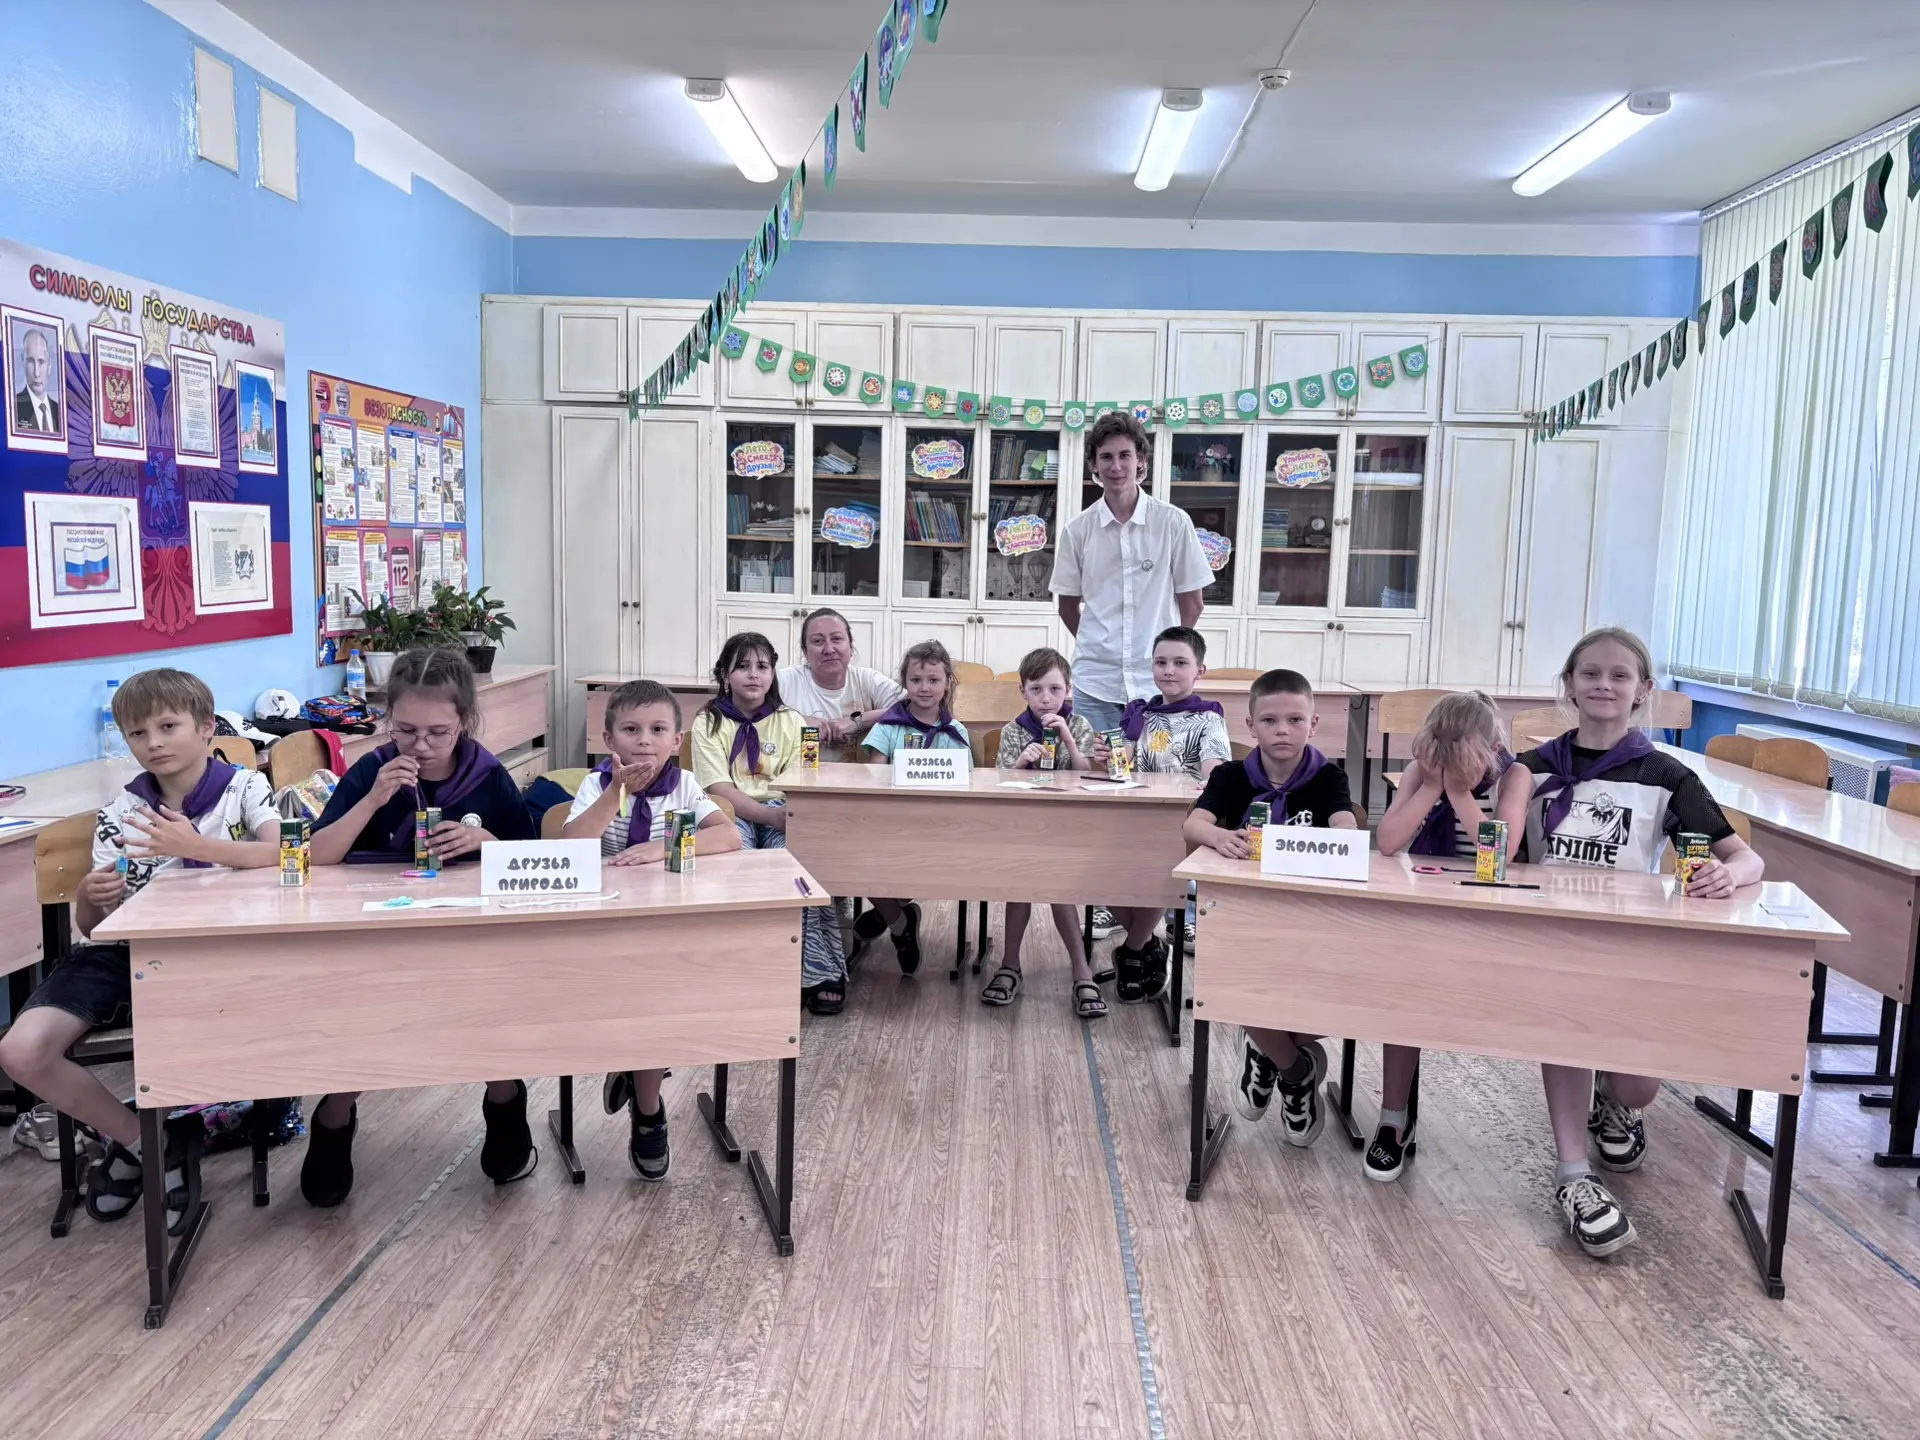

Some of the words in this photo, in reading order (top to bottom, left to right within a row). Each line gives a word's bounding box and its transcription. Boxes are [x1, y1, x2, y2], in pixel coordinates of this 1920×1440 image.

[29, 264, 132, 313] СИМВОЛЫ
[142, 296, 256, 346] ГОСУДАРСТВА
[364, 397, 428, 427] БЕЗОПАСНОСТЬ
[392, 565, 409, 586] 112
[907, 757, 953, 767] ХОЗЯЕВА
[906, 770, 955, 780] ПЛАНЕТЫ
[1275, 838, 1349, 857] ЭКОЛОГИ
[506, 857, 571, 871] ДРУЗЬЯ
[498, 877, 579, 891] ПРИРОДЫ
[1370, 1142, 1394, 1165] LOVE
